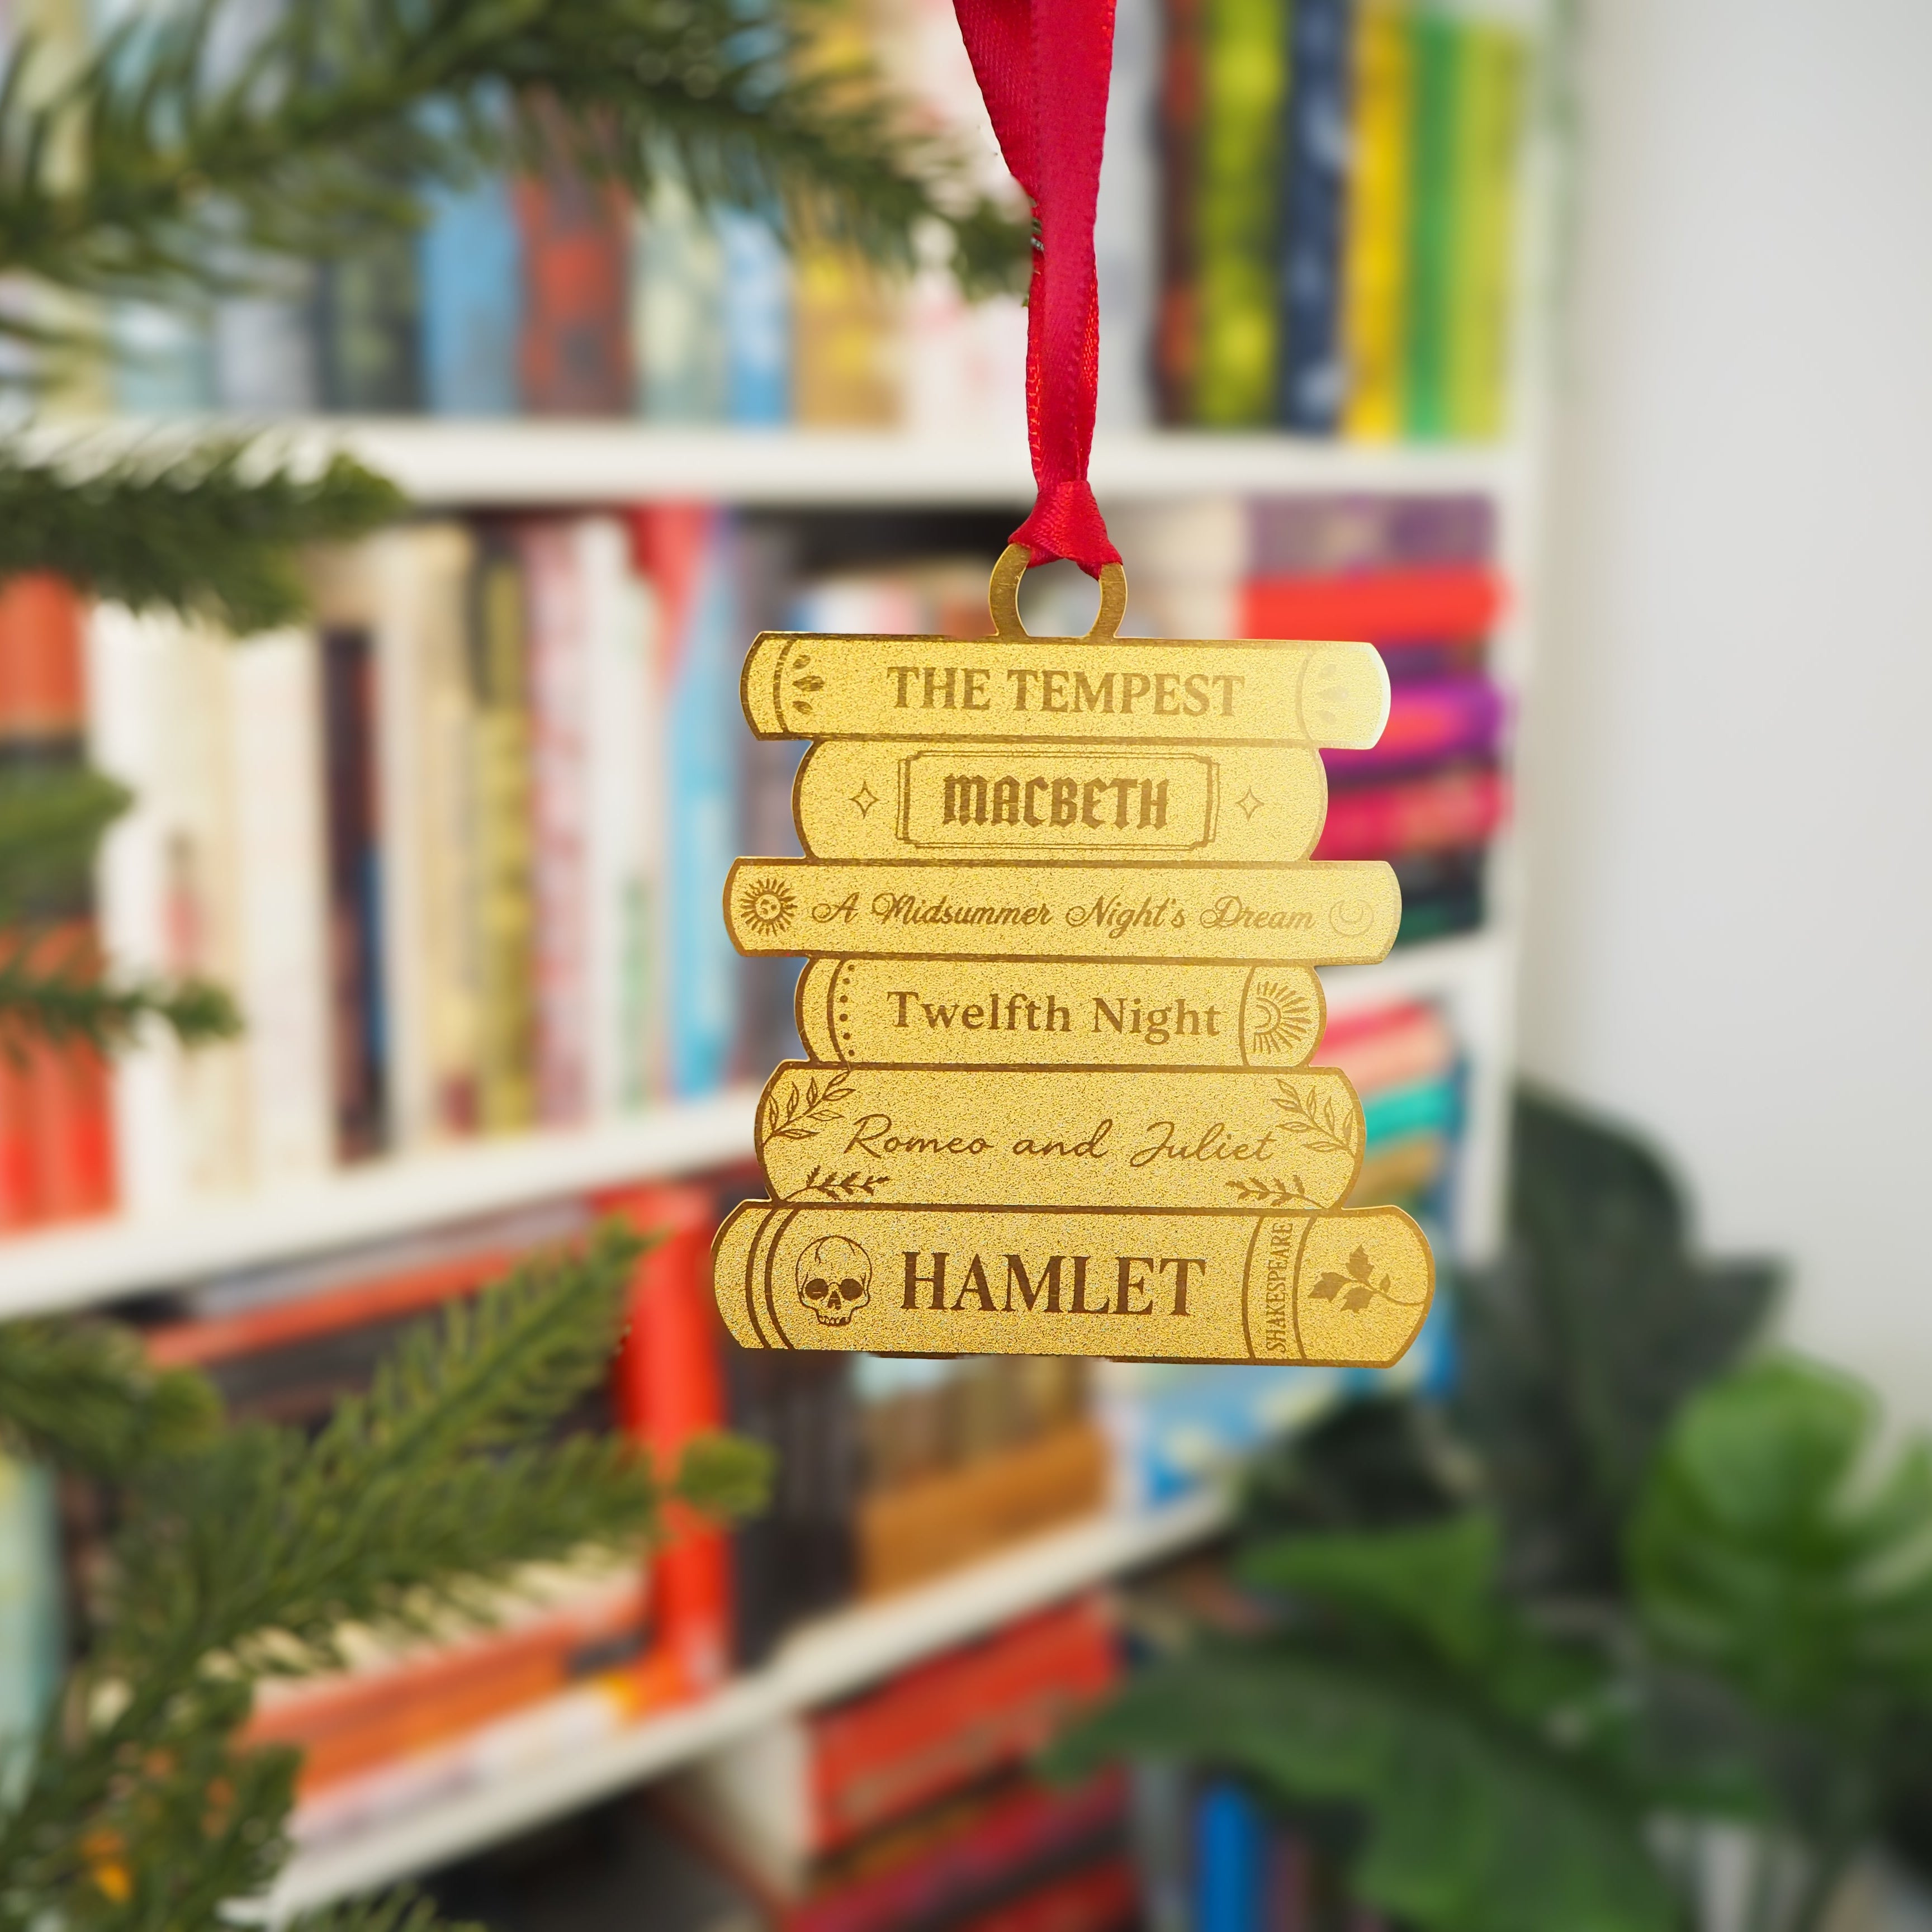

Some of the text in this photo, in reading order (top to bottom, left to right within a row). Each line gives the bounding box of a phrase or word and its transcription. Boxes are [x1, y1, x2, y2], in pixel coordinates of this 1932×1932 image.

[886, 666, 1246, 717] THE TEMPEST
[943, 774, 1170, 831] MACBETH
[812, 892, 1315, 939] A Midsummer Night's Dream
[887, 990, 1220, 1045] Twelfth Night
[843, 1114, 1276, 1167] Romeo and Juliet
[901, 1251, 1206, 1318] HAMLET
[1265, 1221, 1295, 1354] SHAKESPEARE
